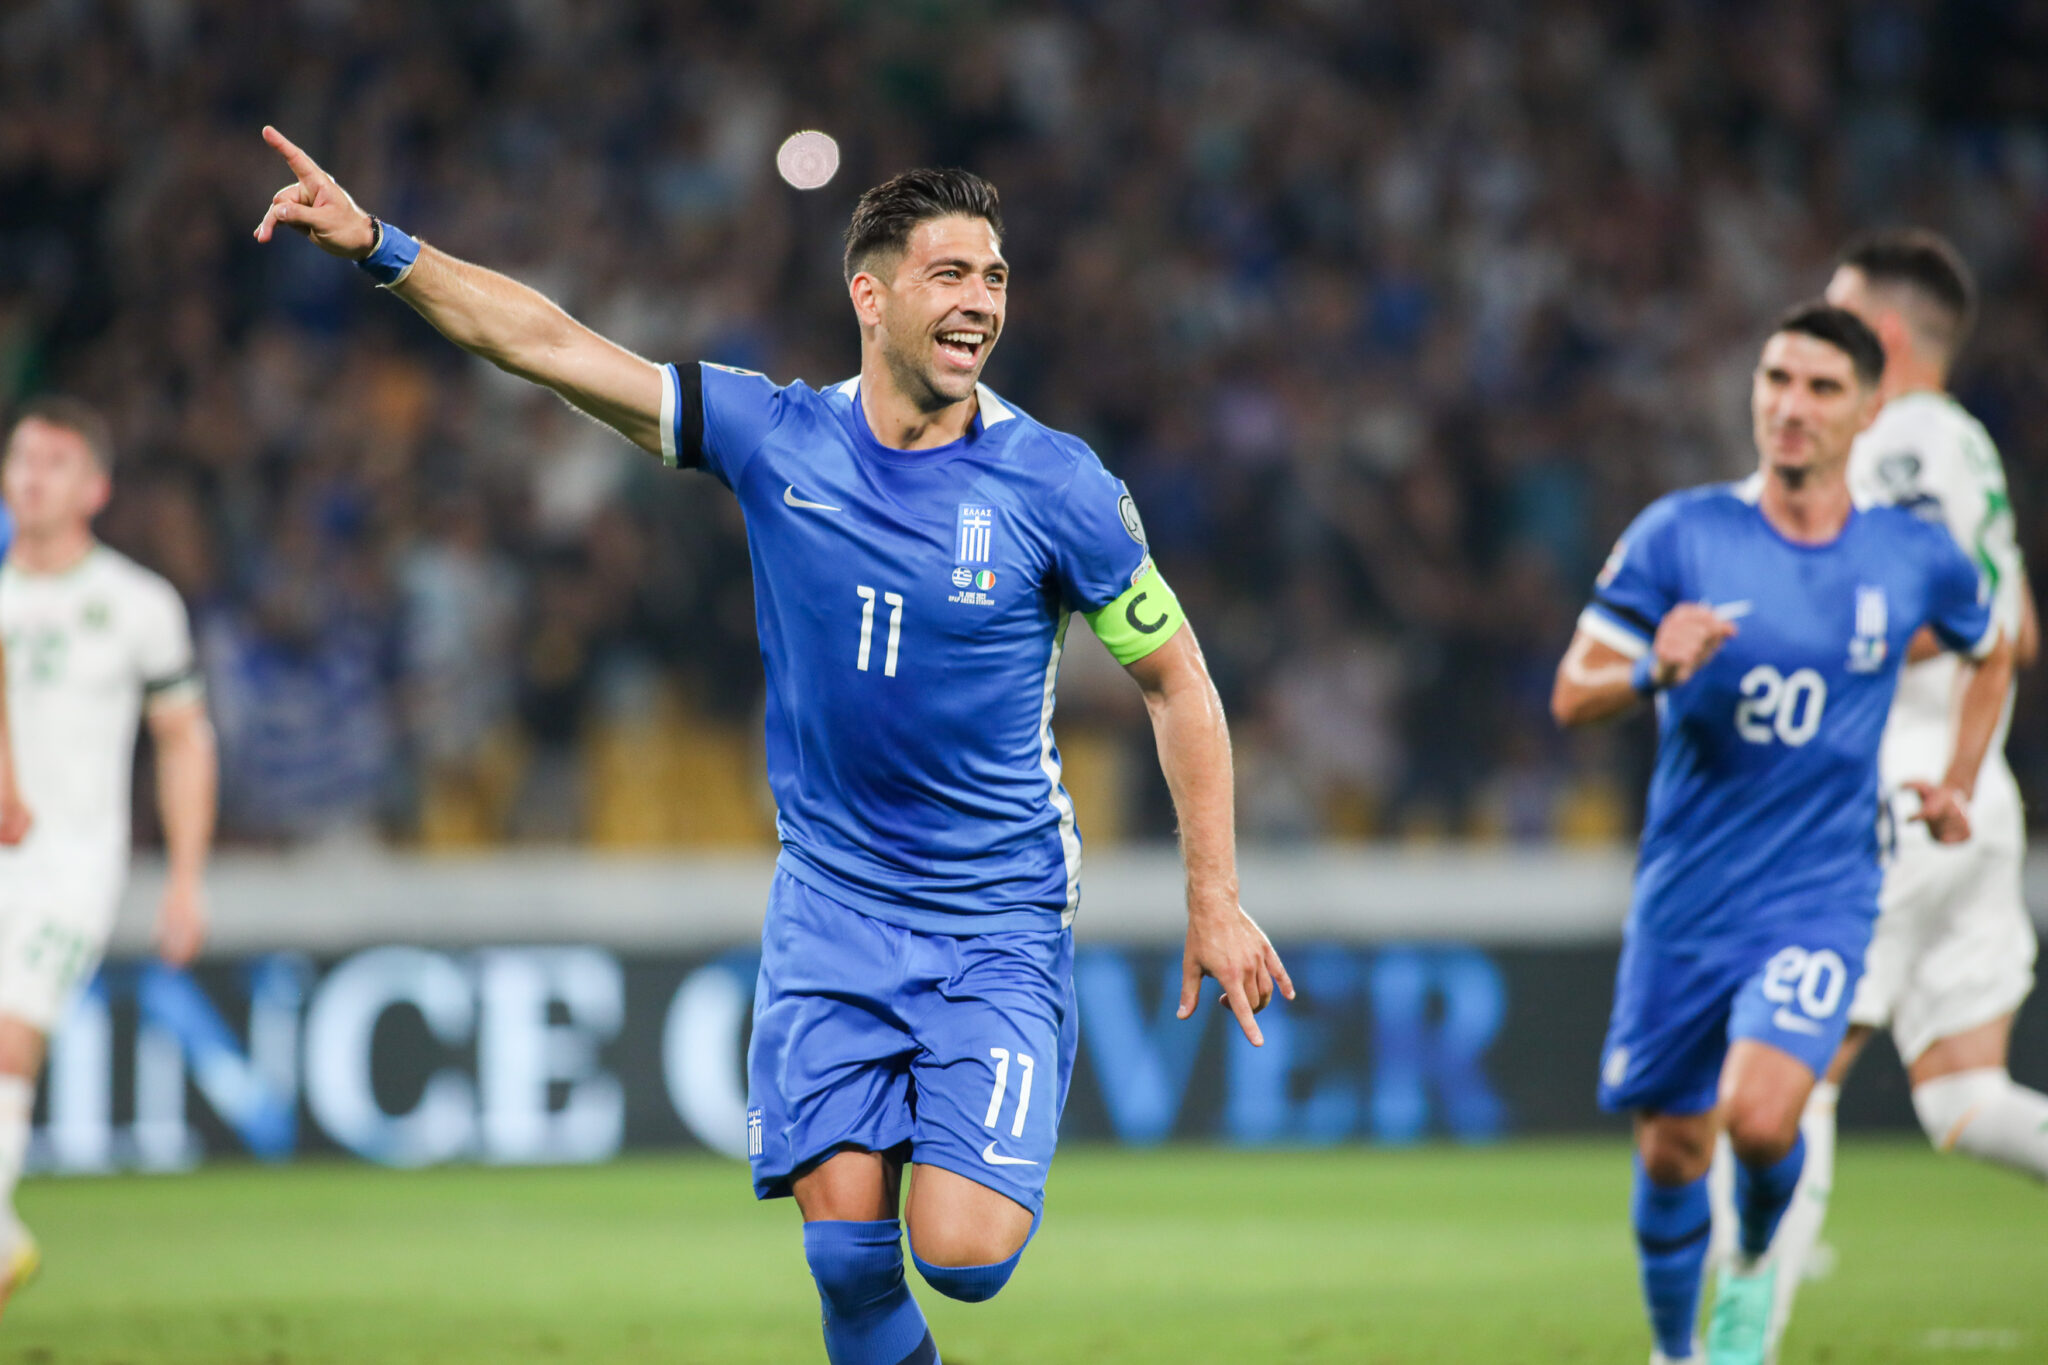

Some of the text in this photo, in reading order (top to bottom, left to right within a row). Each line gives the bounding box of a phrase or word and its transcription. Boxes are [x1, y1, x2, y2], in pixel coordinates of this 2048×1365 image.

[857, 584, 903, 678] 11
[1126, 592, 1168, 634] C
[1735, 664, 1827, 747] 20
[1763, 945, 1847, 1019] 20
[984, 1047, 1034, 1138] 11
